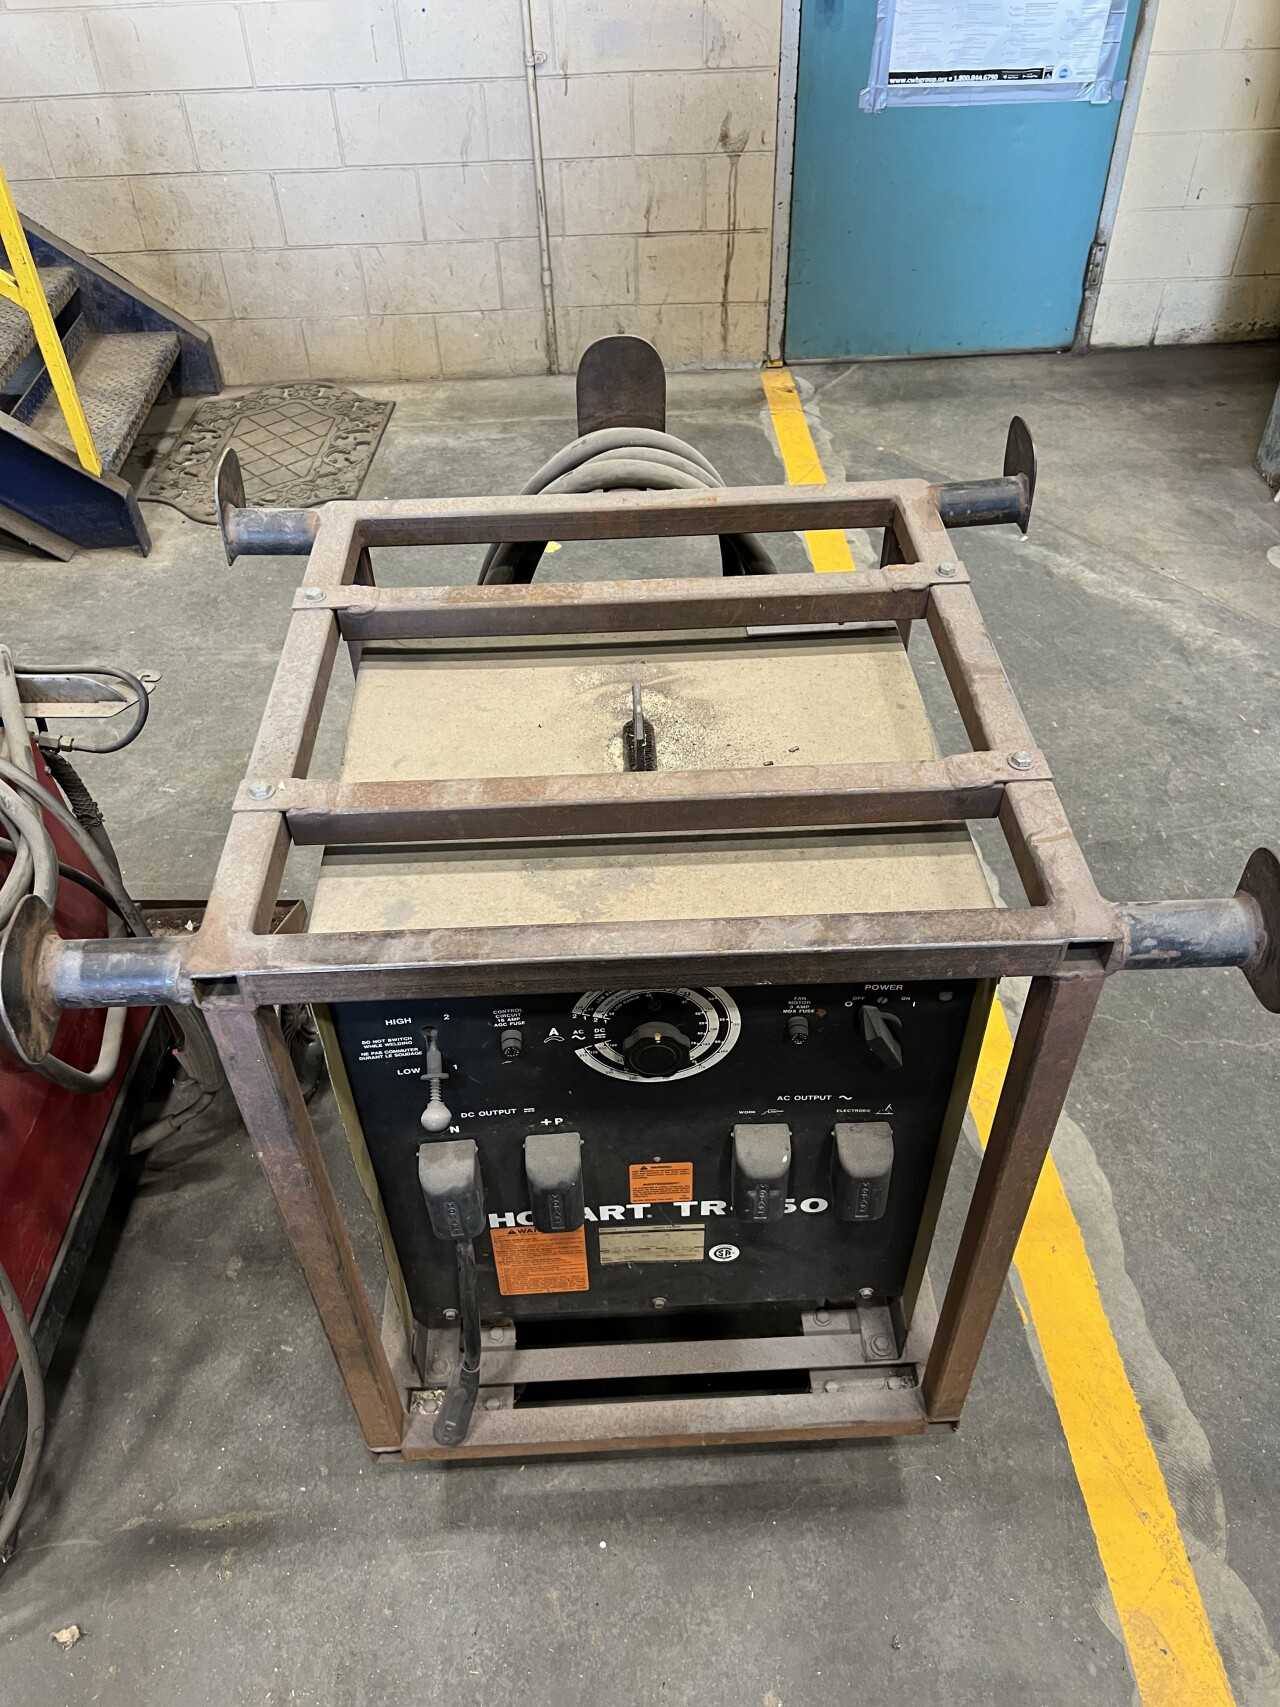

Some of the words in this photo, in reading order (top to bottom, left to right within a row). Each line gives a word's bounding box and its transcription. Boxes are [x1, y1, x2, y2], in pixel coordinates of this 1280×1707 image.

[385, 1017, 412, 1026] HIGH
[549, 1028, 560, 1036] A
[478, 1108, 517, 1117] OUTPUT
[450, 1126, 459, 1134] N
[488, 1203, 651, 1228] HOART
